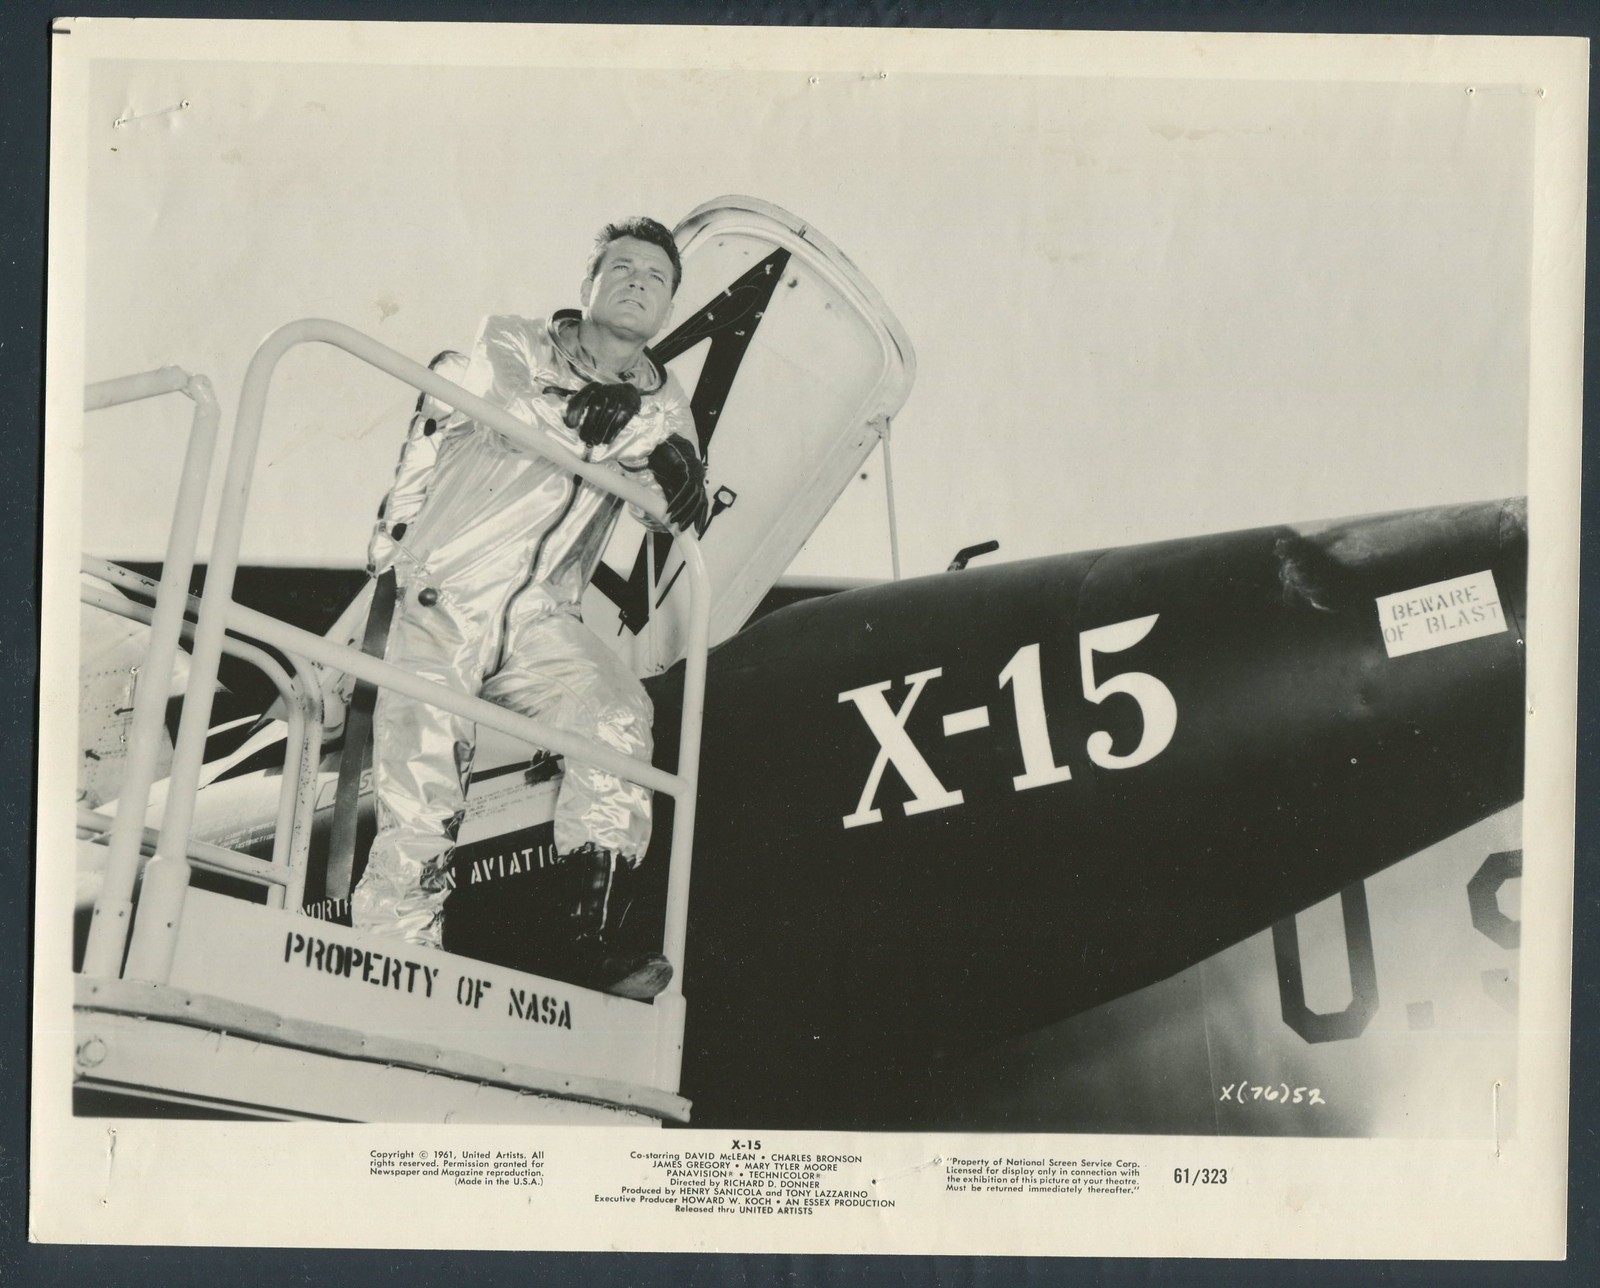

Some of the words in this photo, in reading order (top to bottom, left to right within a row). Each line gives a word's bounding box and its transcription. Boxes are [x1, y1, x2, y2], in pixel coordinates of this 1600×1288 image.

[1392, 585, 1479, 620] BEWARE
[1384, 623, 1408, 643] OF
[1426, 601, 1498, 634] BLAST
[838, 614, 1178, 829] X-15
[285, 932, 439, 999] PROPERTY
[456, 975, 492, 1010] OF
[507, 988, 572, 1030] NASA
[732, 1140, 762, 1150] X-15
[370, 1150, 414, 1159] Copyright
[434, 1151, 456, 1159] 1961,
[630, 1152, 680, 1161] Co-starring
[685, 1152, 715, 1160] DAVID
[771, 1154, 811, 1162] CHARLES
[370, 1160, 395, 1168] rights
[399, 1160, 438, 1168] reserved.
[494, 1161, 527, 1169] granted
[744, 1162, 771, 1170] MARY
[1006, 1159, 1045, 1167] National
[1049, 1159, 1077, 1167] Screen
[1116, 1160, 1140, 1169] Corp.
[370, 1169, 420, 1177] Newspaper
[441, 1169, 483, 1177] Magazine
[487, 1169, 544, 1178] reproduction.
[946, 1167, 983, 1175] Licensed
[986, 1167, 999, 1175] for
[1002, 1167, 1034, 1177] display
[1038, 1168, 1056, 1177] only
[1071, 1168, 1117, 1176] connection
[1120, 1168, 1140, 1176] with
[1173, 1168, 1227, 1186] 61/323
[455, 1178, 482, 1186] (Made
[514, 1178, 543, 1186] U.S.A.)
[709, 1179, 721, 1188] by
[724, 1180, 764, 1188] RICHARD
[768, 1180, 777, 1188] D.
[780, 1180, 820, 1188] DONNER
[947, 1175, 961, 1183] the
[1010, 1176, 1019, 1184] of
[1022, 1176, 1038, 1184] this
[1040, 1176, 1070, 1186] picture
[1083, 1178, 1103, 1186] your
[1106, 1177, 1139, 1185] theatre.
[622, 1186, 661, 1194] Produced
[664, 1187, 676, 1196] by
[679, 1188, 710, 1196] HENRY
[714, 1188, 762, 1196] SANICOLA
[786, 1190, 812, 1198] TONY
[815, 1190, 868, 1198] LAZZARINO
[946, 1184, 966, 1192] Must
[1028, 1185, 1083, 1195] immediately
[594, 1195, 636, 1203] Executive
[640, 1196, 678, 1204] Producer
[682, 1196, 725, 1204] HOWARD
[728, 1197, 741, 1205] W.
[786, 1198, 800, 1206] AN
[834, 1200, 895, 1208] PRODUCTION
[675, 1205, 714, 1213] Released
[718, 1206, 735, 1214] thru
[739, 1206, 774, 1214] UNITED
[777, 1207, 813, 1215] ARTISTS
